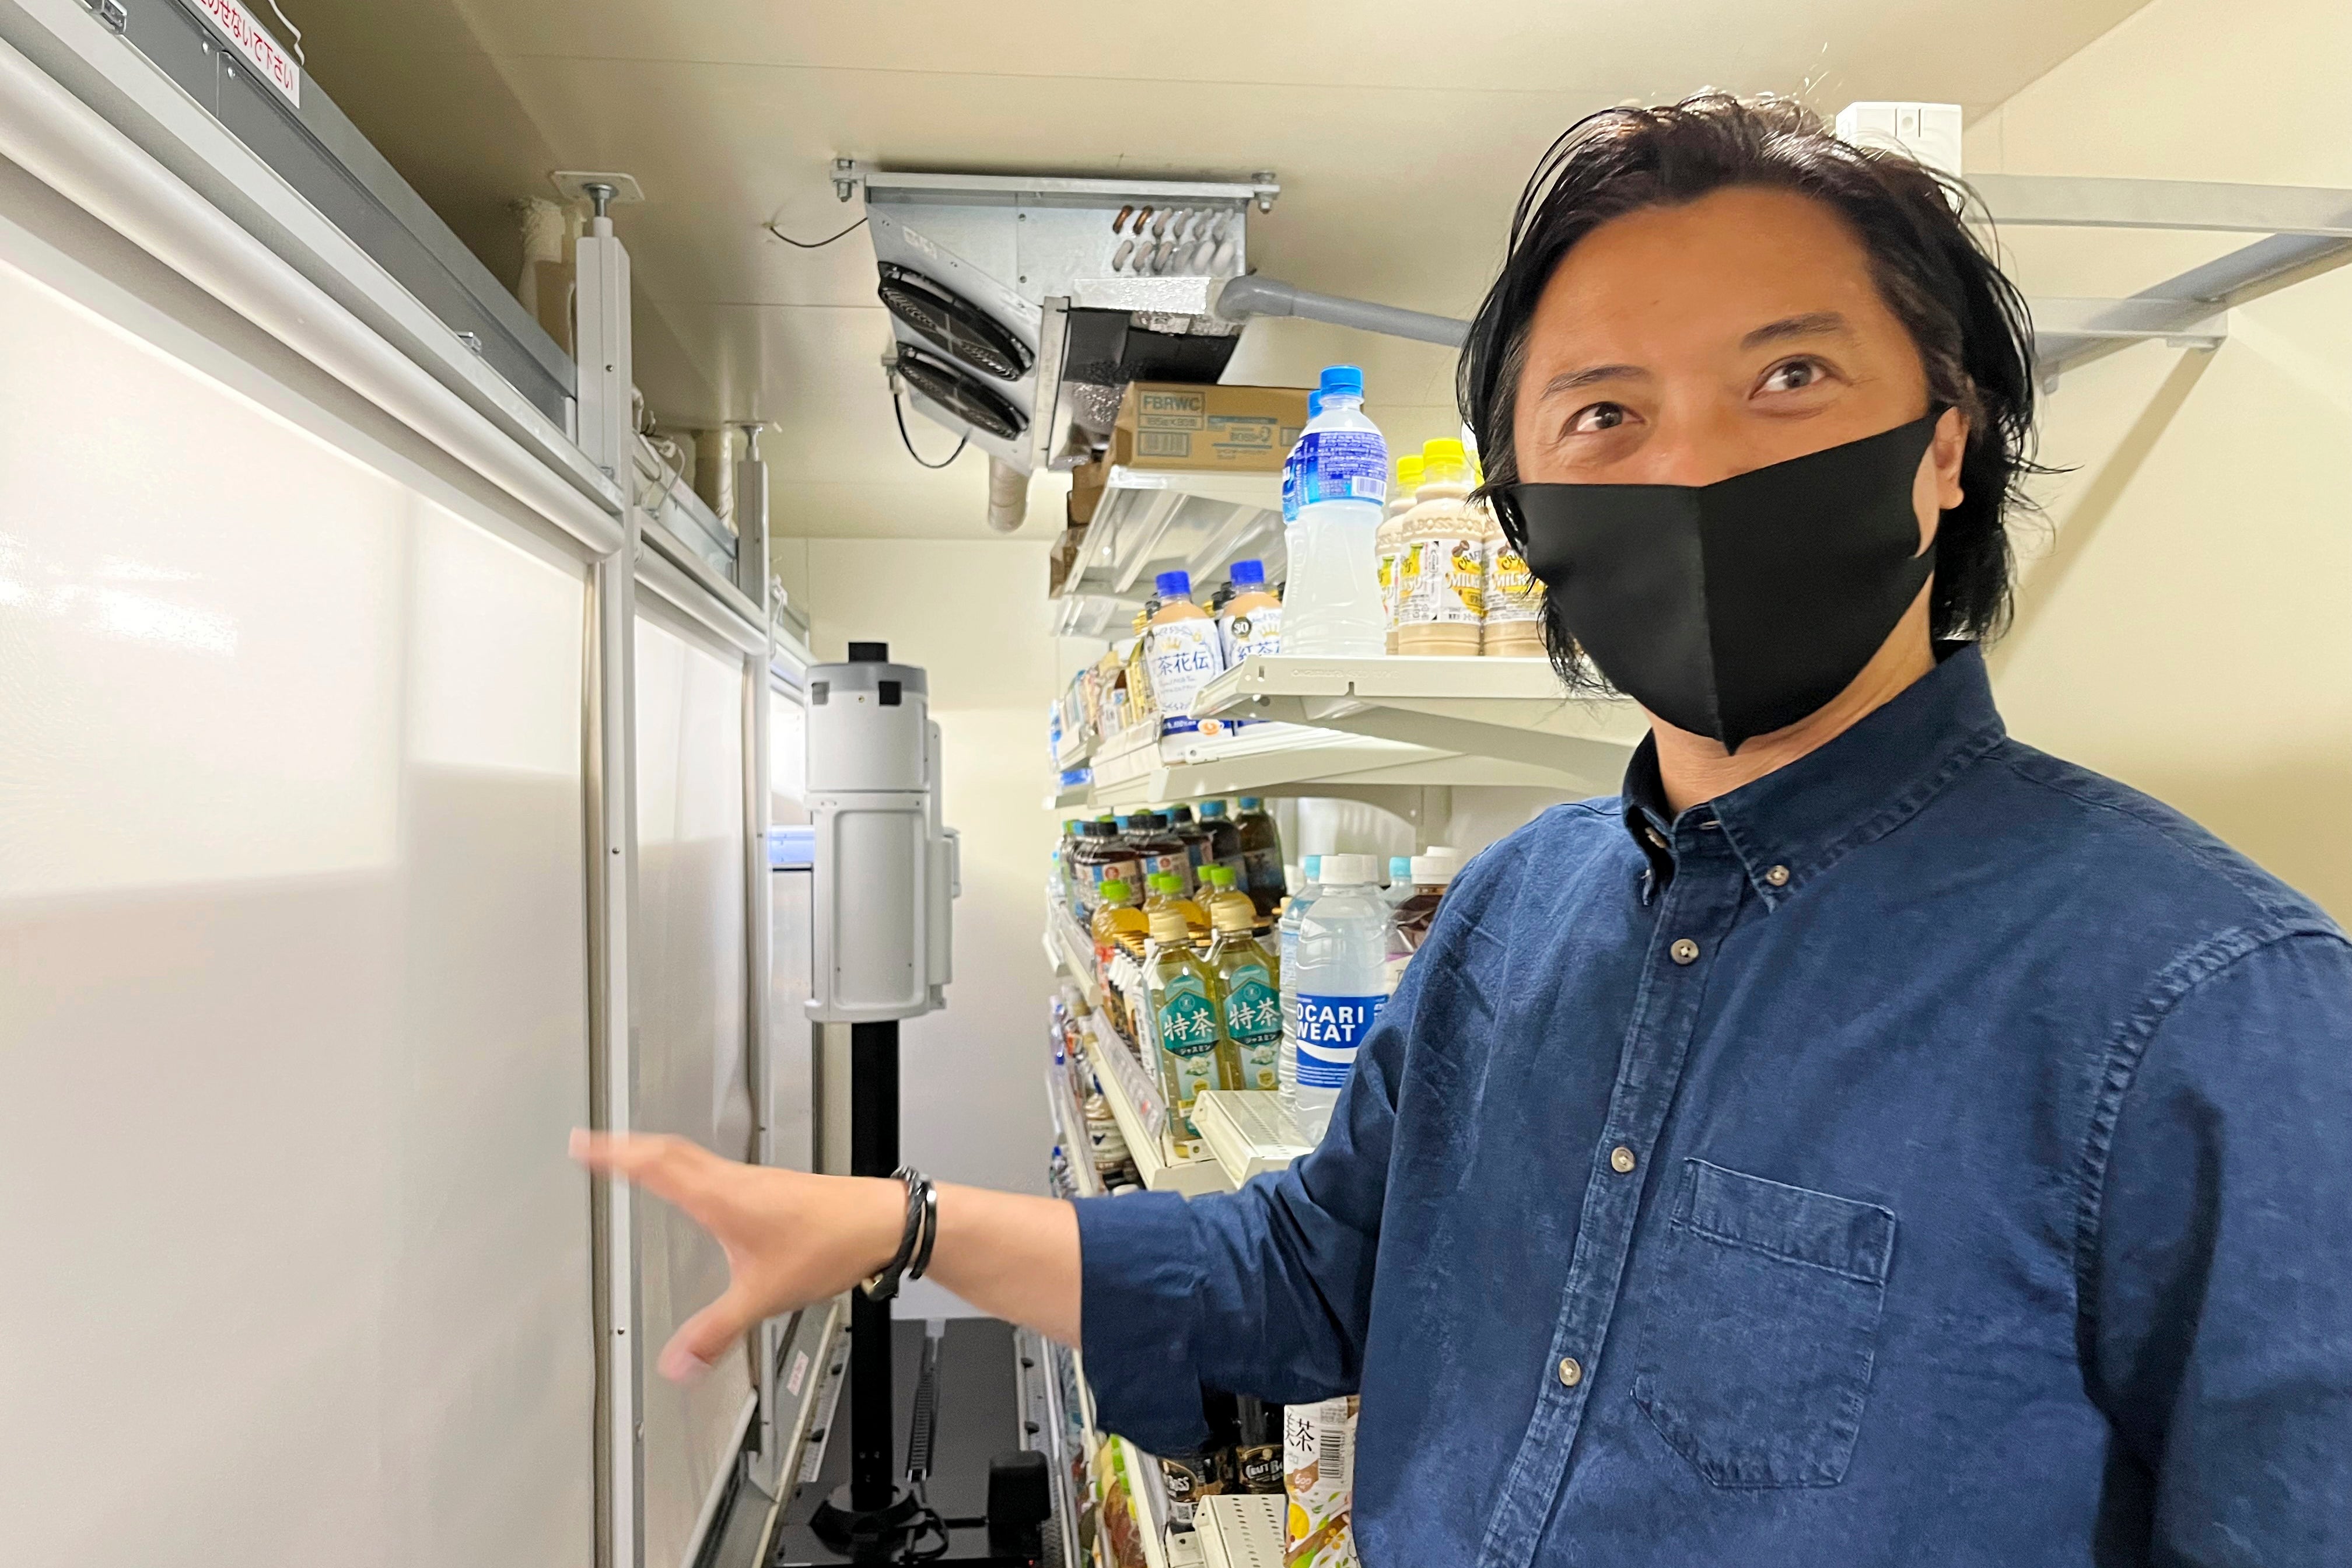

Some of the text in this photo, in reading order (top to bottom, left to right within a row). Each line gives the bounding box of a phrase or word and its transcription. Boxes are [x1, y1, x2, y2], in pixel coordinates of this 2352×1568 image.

[201, 0, 293, 90] のせないで下さい
[1143, 395, 1200, 411] FBRWC
[1164, 1007, 1216, 1041] 特茶
[1228, 996, 1281, 1030] 特茶
